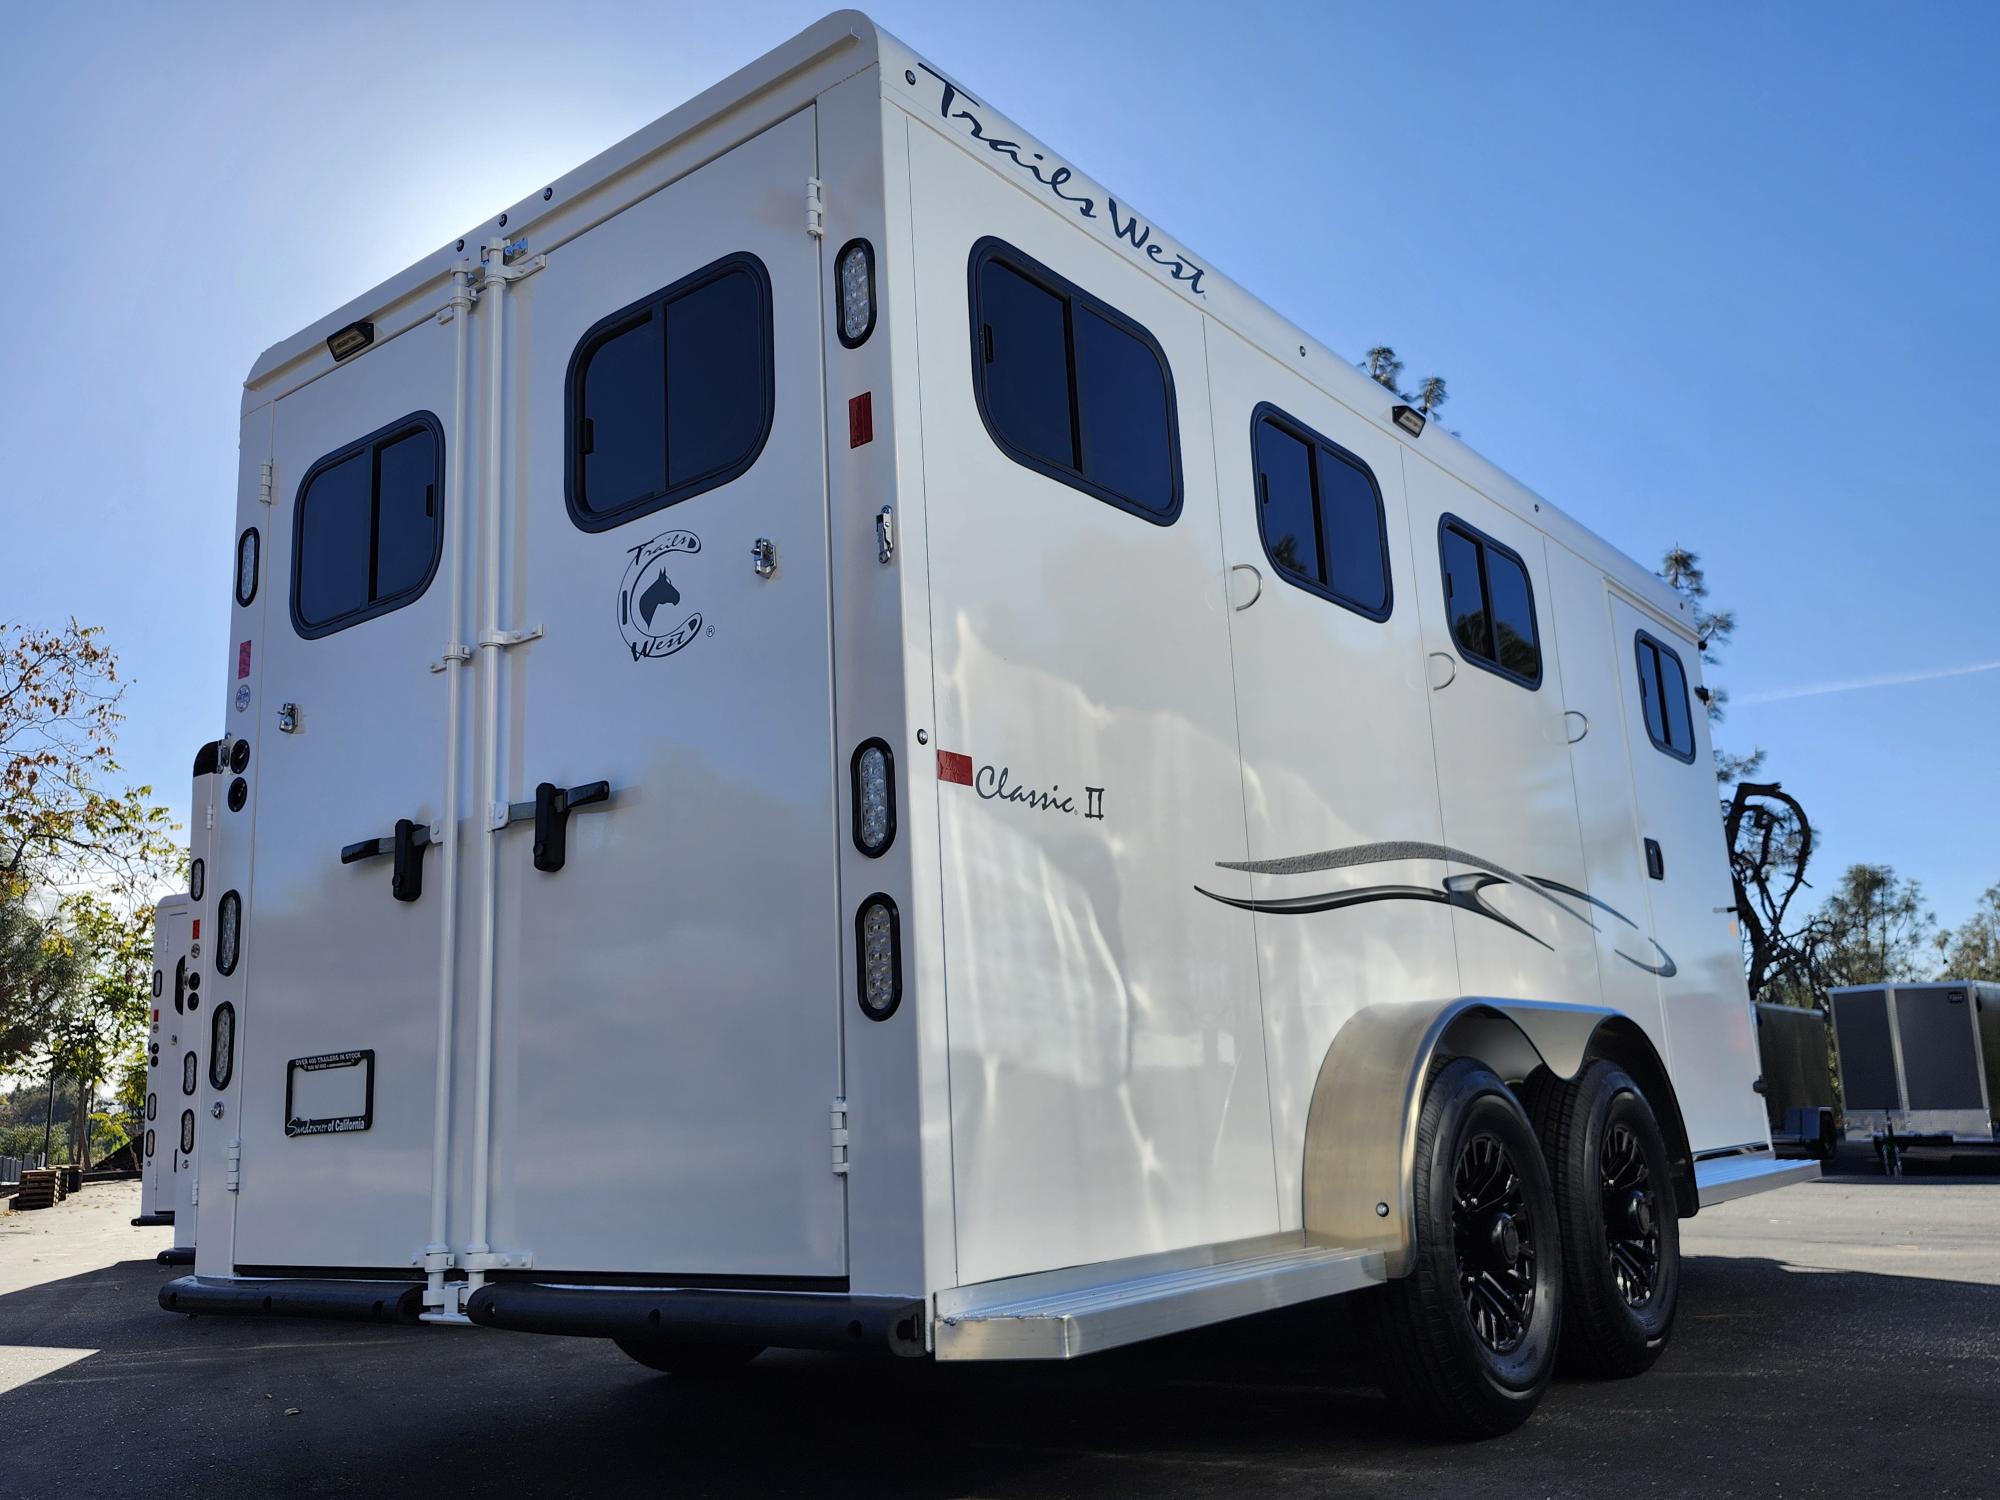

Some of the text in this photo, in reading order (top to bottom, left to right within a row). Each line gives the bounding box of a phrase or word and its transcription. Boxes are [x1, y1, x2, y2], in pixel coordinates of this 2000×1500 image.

[917, 61, 1204, 294] Trails West
[626, 533, 688, 566] Trails
[630, 630, 686, 662] West
[975, 765, 1105, 820] Classic II
[295, 1058, 309, 1066] OVER
[318, 1055, 339, 1063] TRAILERS
[345, 1052, 362, 1060] STOCK
[286, 1117, 365, 1137] Sundowner of California
